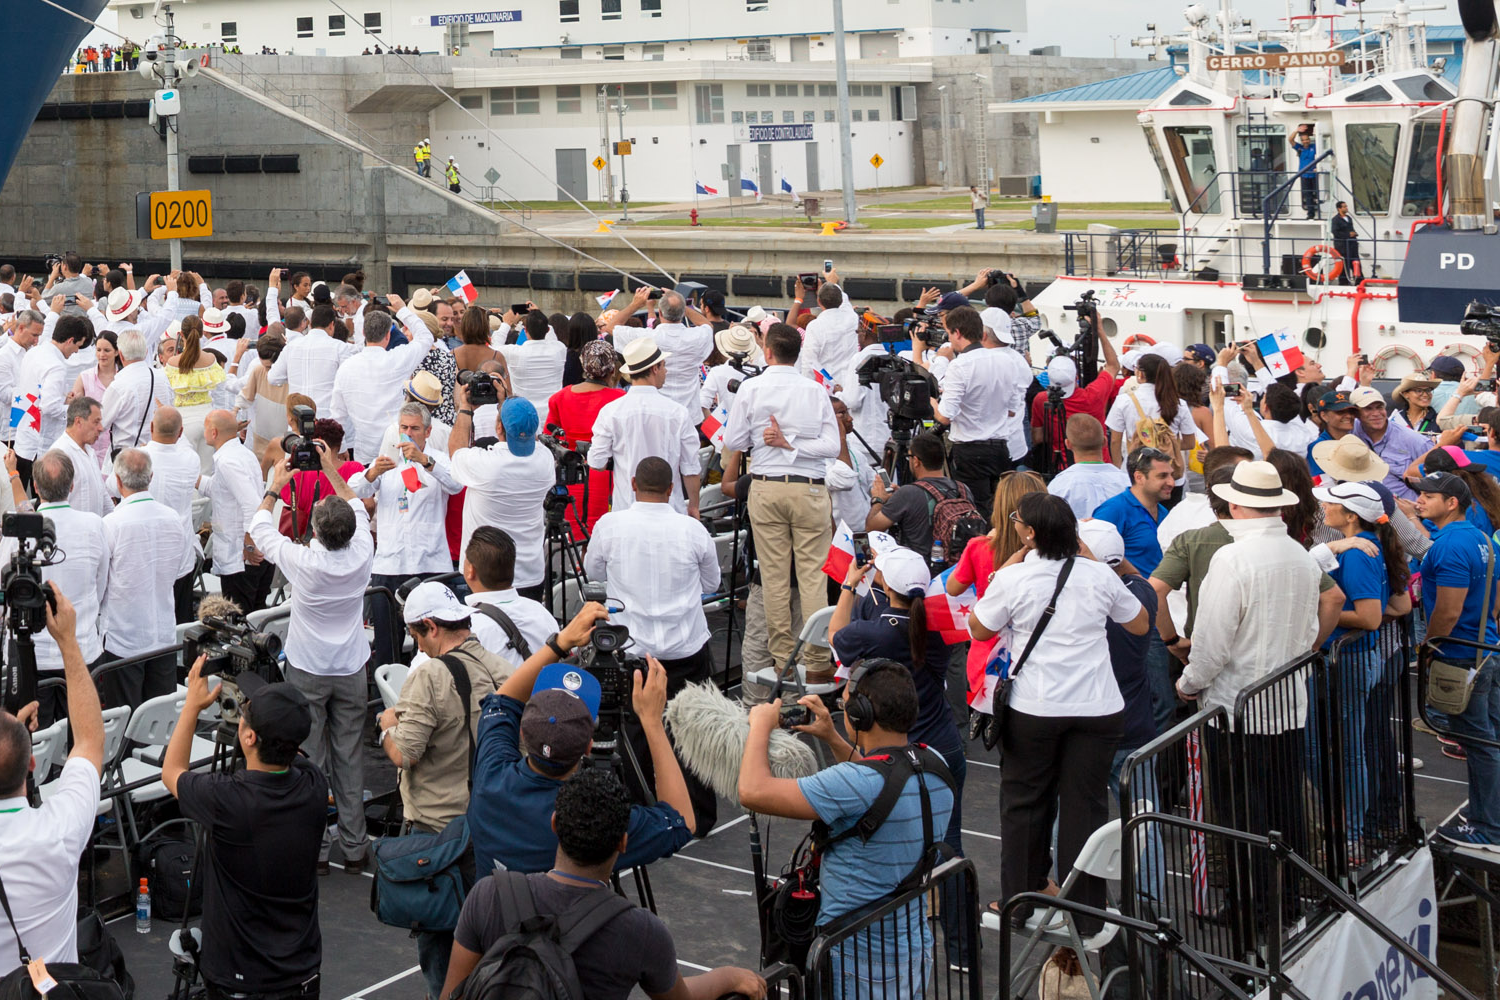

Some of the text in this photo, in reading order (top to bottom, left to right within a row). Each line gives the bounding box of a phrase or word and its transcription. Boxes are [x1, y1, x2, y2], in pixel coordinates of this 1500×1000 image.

[438, 11, 514, 25] EDIFICIO DE MAQUINARIA
[1209, 52, 1340, 69] CERRO PANDO
[155, 199, 208, 230] 0200
[1440, 252, 1475, 270] PD
